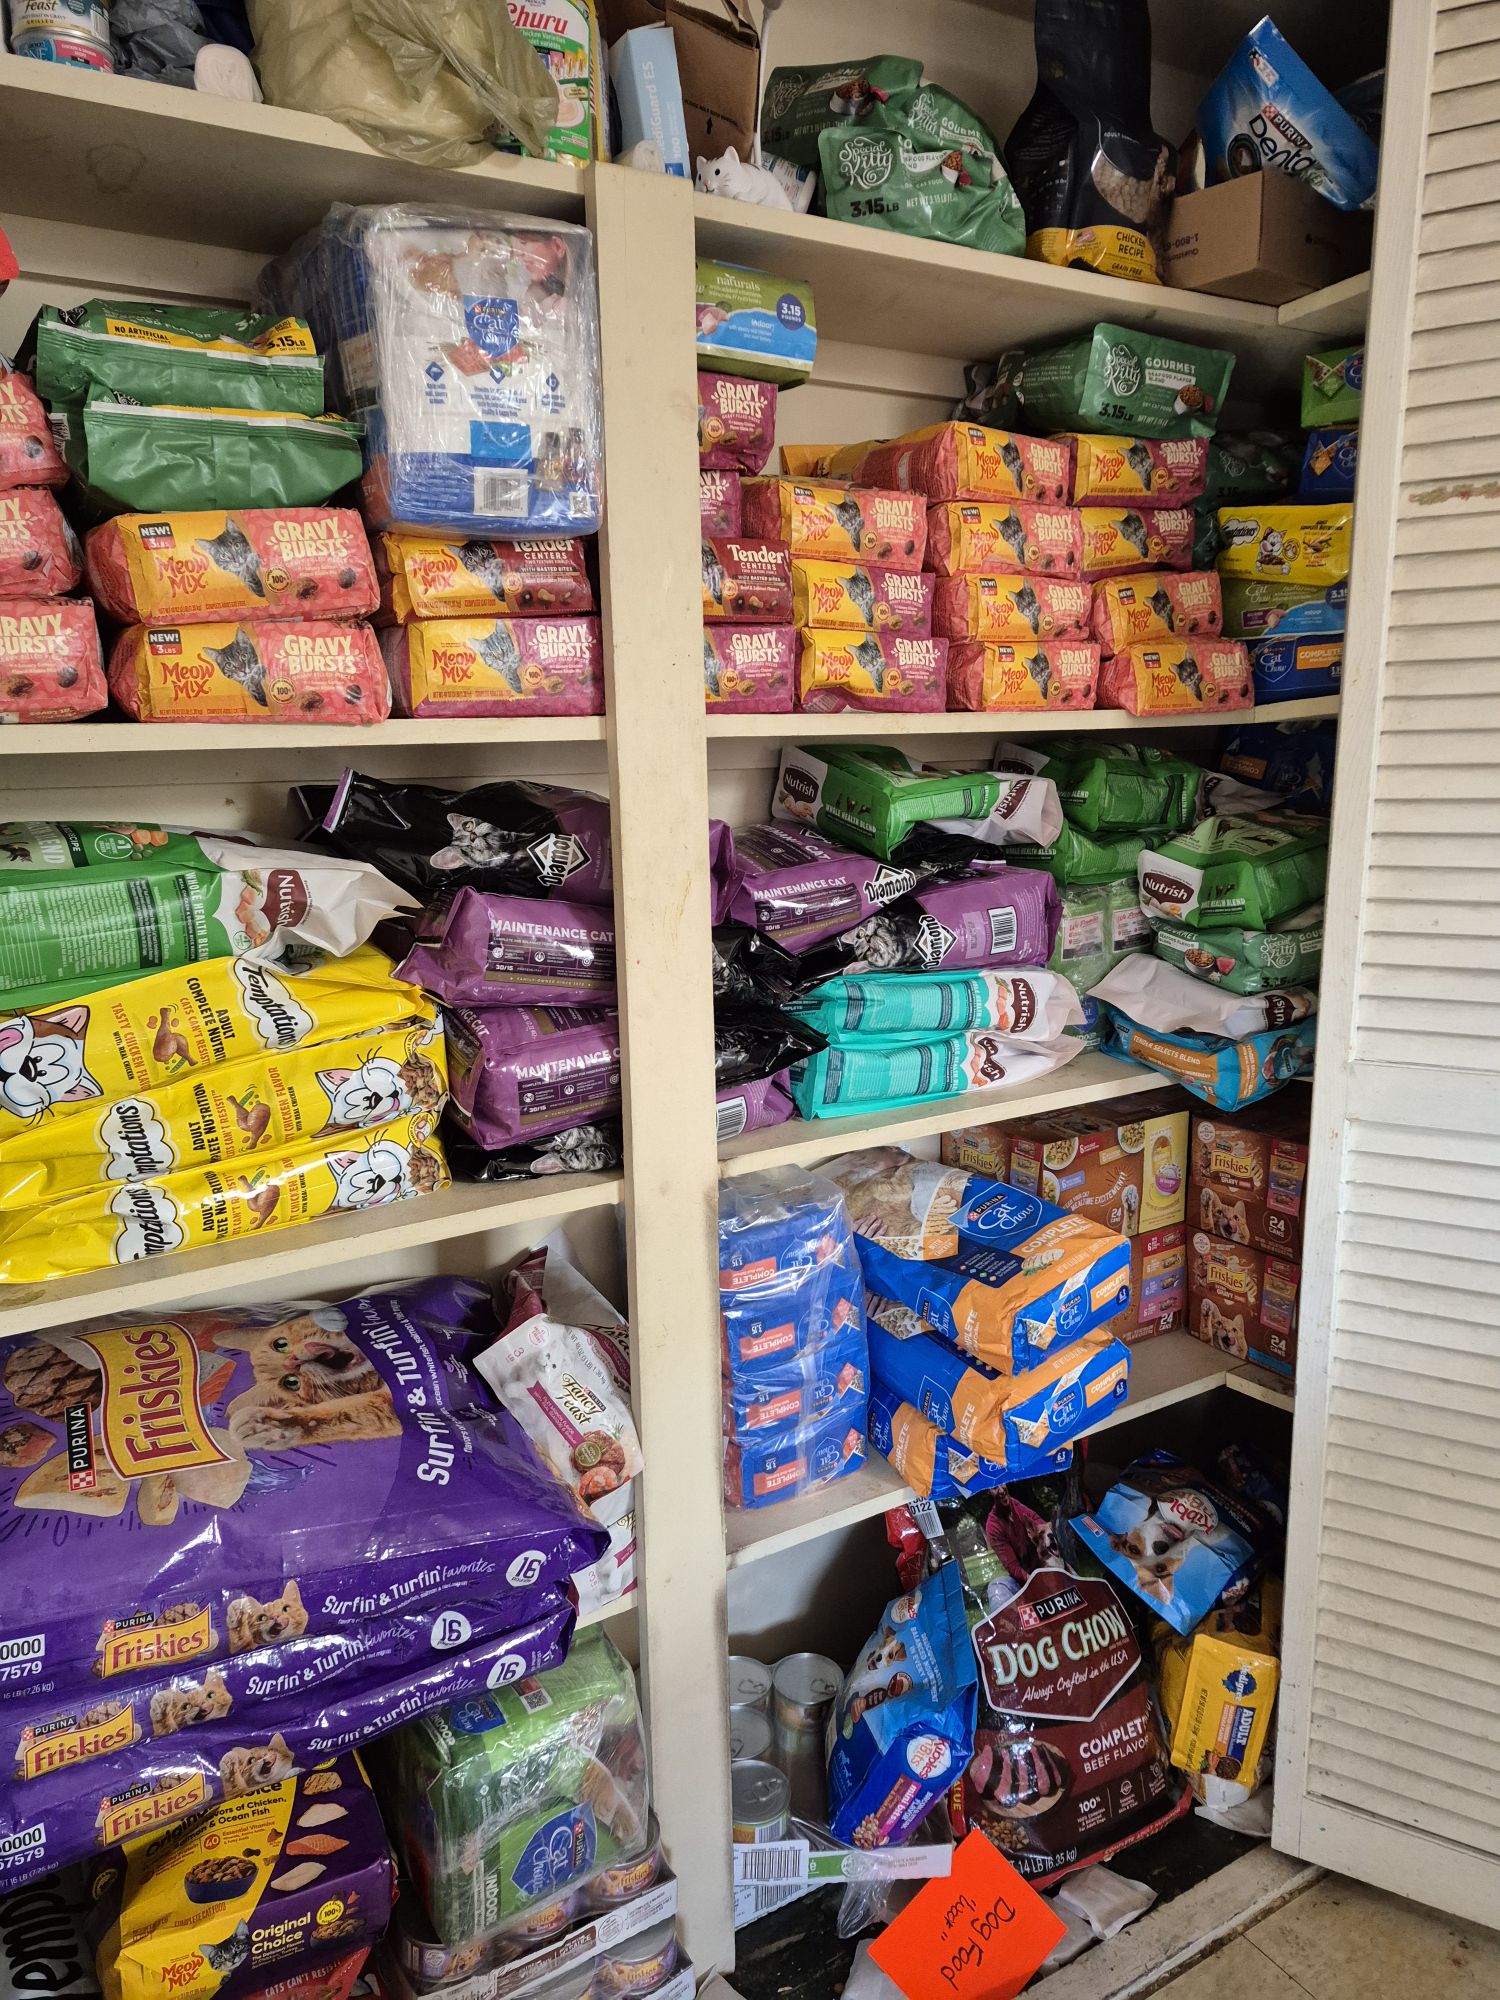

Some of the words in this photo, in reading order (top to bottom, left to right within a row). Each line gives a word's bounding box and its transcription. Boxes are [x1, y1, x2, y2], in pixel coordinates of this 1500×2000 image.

[850, 197, 885, 218] 3.15
[1118, 244, 1145, 259] RECIPE
[717, 272, 761, 293] naturals
[780, 303, 802, 318] 3.15
[114, 325, 127, 335] NO
[127, 326, 170, 343] ARTIFICIAL
[1144, 356, 1197, 375] GOURMET
[716, 380, 760, 401] GRAVY
[719, 399, 764, 419] BURSTS
[1030, 442, 1062, 462] GRAVY
[1160, 439, 1198, 453] GRAVY
[1166, 450, 1201, 464] BURSTS
[1033, 459, 1063, 477] BURSTS
[874, 497, 914, 514] GRAVY
[140, 525, 172, 538] NEW!
[273, 517, 341, 543] GRAVY
[876, 512, 914, 532] BURSTS
[1035, 513, 1073, 531] GRAVY
[1037, 527, 1074, 543] BURSTS
[281, 537, 349, 562] BURSTS
[523, 551, 568, 561] CENTERS
[726, 543, 784, 564] Tender
[154, 547, 210, 581] Meow
[410, 549, 459, 578] Meow
[740, 562, 778, 571] CENTERS
[812, 578, 844, 600] Meow
[884, 571, 923, 590] GRAVY
[888, 586, 926, 605] BURSTS
[150, 632, 180, 643] NEW!
[284, 634, 353, 657] GRAVY
[535, 624, 588, 645] GRAVY
[731, 632, 778, 652] GRAVY
[894, 637, 934, 655] GRAVY
[431, 642, 477, 671] Meow
[538, 641, 592, 660] BURSTS
[734, 648, 781, 664] BURSTS
[820, 644, 856, 668] Meow
[898, 651, 938, 669] BURSTS
[1060, 649, 1093, 667] GRAVY
[161, 654, 215, 684] Meow
[288, 653, 357, 676] BURSTS
[1062, 662, 1093, 678] BURSTS
[784, 773, 816, 797] Nutrish
[859, 819, 877, 833] BLEND
[753, 878, 829, 900] MAINTENANCE
[828, 876, 848, 887] CAT
[864, 869, 917, 904] Diamond
[1144, 876, 1189, 900] Nutrish
[276, 874, 296, 928] Nutrish
[490, 919, 588, 940] MAINTENANCE
[590, 930, 615, 943] CAT
[922, 914, 943, 970] Diamond
[186, 976, 215, 1028] COMPLETE
[241, 964, 298, 1047] Temptations
[1016, 981, 1031, 1032] Nutrish
[179, 996, 194, 1016] CATS
[188, 1013, 203, 1038] CAN'T
[215, 1007, 236, 1041] ADULT
[110, 1002, 132, 1030] TASTY
[123, 1030, 144, 1069] CHICKEN
[1132, 1034, 1152, 1050] TENDER
[1153, 1042, 1179, 1058] SELECTS
[1178, 1053, 1201, 1065] BLEND
[122, 1059, 136, 1081] CHICKEN
[515, 1048, 612, 1080] MAINTENANCE
[192, 1082, 217, 1134] NUTRITION
[188, 1121, 206, 1152] ADULT
[962, 1151, 994, 1170] Friskies
[1214, 1153, 1250, 1175] Friskies
[975, 1194, 1004, 1215] PURINA
[977, 1201, 1018, 1230] Cat
[1111, 1207, 1122, 1218] 24
[999, 1203, 1035, 1230] Chow
[1269, 1215, 1286, 1232] 24
[1020, 1216, 1086, 1254] COMPLETE
[1268, 1227, 1286, 1238] CANS
[732, 1268, 776, 1286] COMPLETE
[1095, 1271, 1127, 1299] COMPLETE
[1209, 1266, 1244, 1289] Friskies
[1064, 1295, 1081, 1310] PURINA
[1159, 1321, 1172, 1331] CANS
[1160, 1311, 1174, 1326] 24
[752, 1333, 794, 1354] COMPLETE
[1270, 1334, 1286, 1350] 24
[815, 1384, 835, 1399] Cat
[1090, 1366, 1125, 1395] COMPLETE
[119, 1328, 201, 1464] Friskies
[406, 1386, 428, 1407] &
[562, 1372, 603, 1416] Fancy
[1057, 1391, 1076, 1408] PURINA
[556, 1387, 592, 1426] Feast
[759, 1400, 800, 1420] COMPLETE
[71, 1406, 90, 1470] PURINA
[820, 1450, 841, 1465] Cat
[910, 1500, 933, 1515] 0122
[518, 1555, 543, 1580] 16
[321, 1593, 379, 1616] Surfin'
[378, 1592, 392, 1604] &
[388, 1565, 442, 1602] Turfin'
[440, 1558, 497, 1580] favorites
[1035, 1590, 1083, 1618] PURINA
[114, 1613, 155, 1631] PURINA
[441, 1616, 464, 1643] 16
[112, 1629, 205, 1671] Friskies
[986, 1632, 1061, 1688] DOG
[1060, 1604, 1129, 1662] CHOW
[245, 1670, 303, 1697] Surfin'
[302, 1667, 316, 1682] &
[312, 1634, 365, 1676] Turfin'
[498, 1661, 521, 1684] 16
[1021, 1683, 1055, 1704] Always
[1056, 1669, 1089, 1697] Crafted
[1089, 1665, 1101, 1680] in
[1099, 1659, 1111, 1674] the
[1110, 1649, 1129, 1668] USA
[1233, 1663, 1251, 1703] Pedigree
[306, 1728, 362, 1752] Surfin'
[362, 1722, 375, 1734] &
[372, 1692, 423, 1729] Turfin'
[421, 1676, 479, 1704] favorites
[34, 1717, 76, 1738] PURINA
[1236, 1707, 1255, 1746] ADULT
[33, 1726, 130, 1774] Friskies
[1083, 1753, 1112, 1774] BEEF
[111, 1784, 151, 1806] PURINA
[235, 1801, 246, 1813] of
[245, 1795, 288, 1810] Chicken,
[112, 1787, 200, 1839] Friskies
[208, 1819, 218, 1830] &
[217, 1811, 251, 1826] Ocean
[251, 1806, 271, 1819] Fish
[205, 1836, 220, 1848] 40
[222, 1825, 249, 1838] Essential
[550, 1825, 574, 1875] Cat
[576, 1832, 586, 1868] PURINA
[1018, 1859, 1031, 1874] 14
[1031, 1856, 1045, 1873] LB
[1064, 1847, 1078, 1867] kg)
[250, 1911, 312, 1943] Original
[970, 1895, 1016, 1943] Dog
[250, 1930, 304, 1956] Choice
[161, 1950, 206, 1981] Meow
[940, 1937, 985, 1991] Food
[264, 1982, 286, 1999] CATS
[286, 1973, 310, 1989] CAN'T
